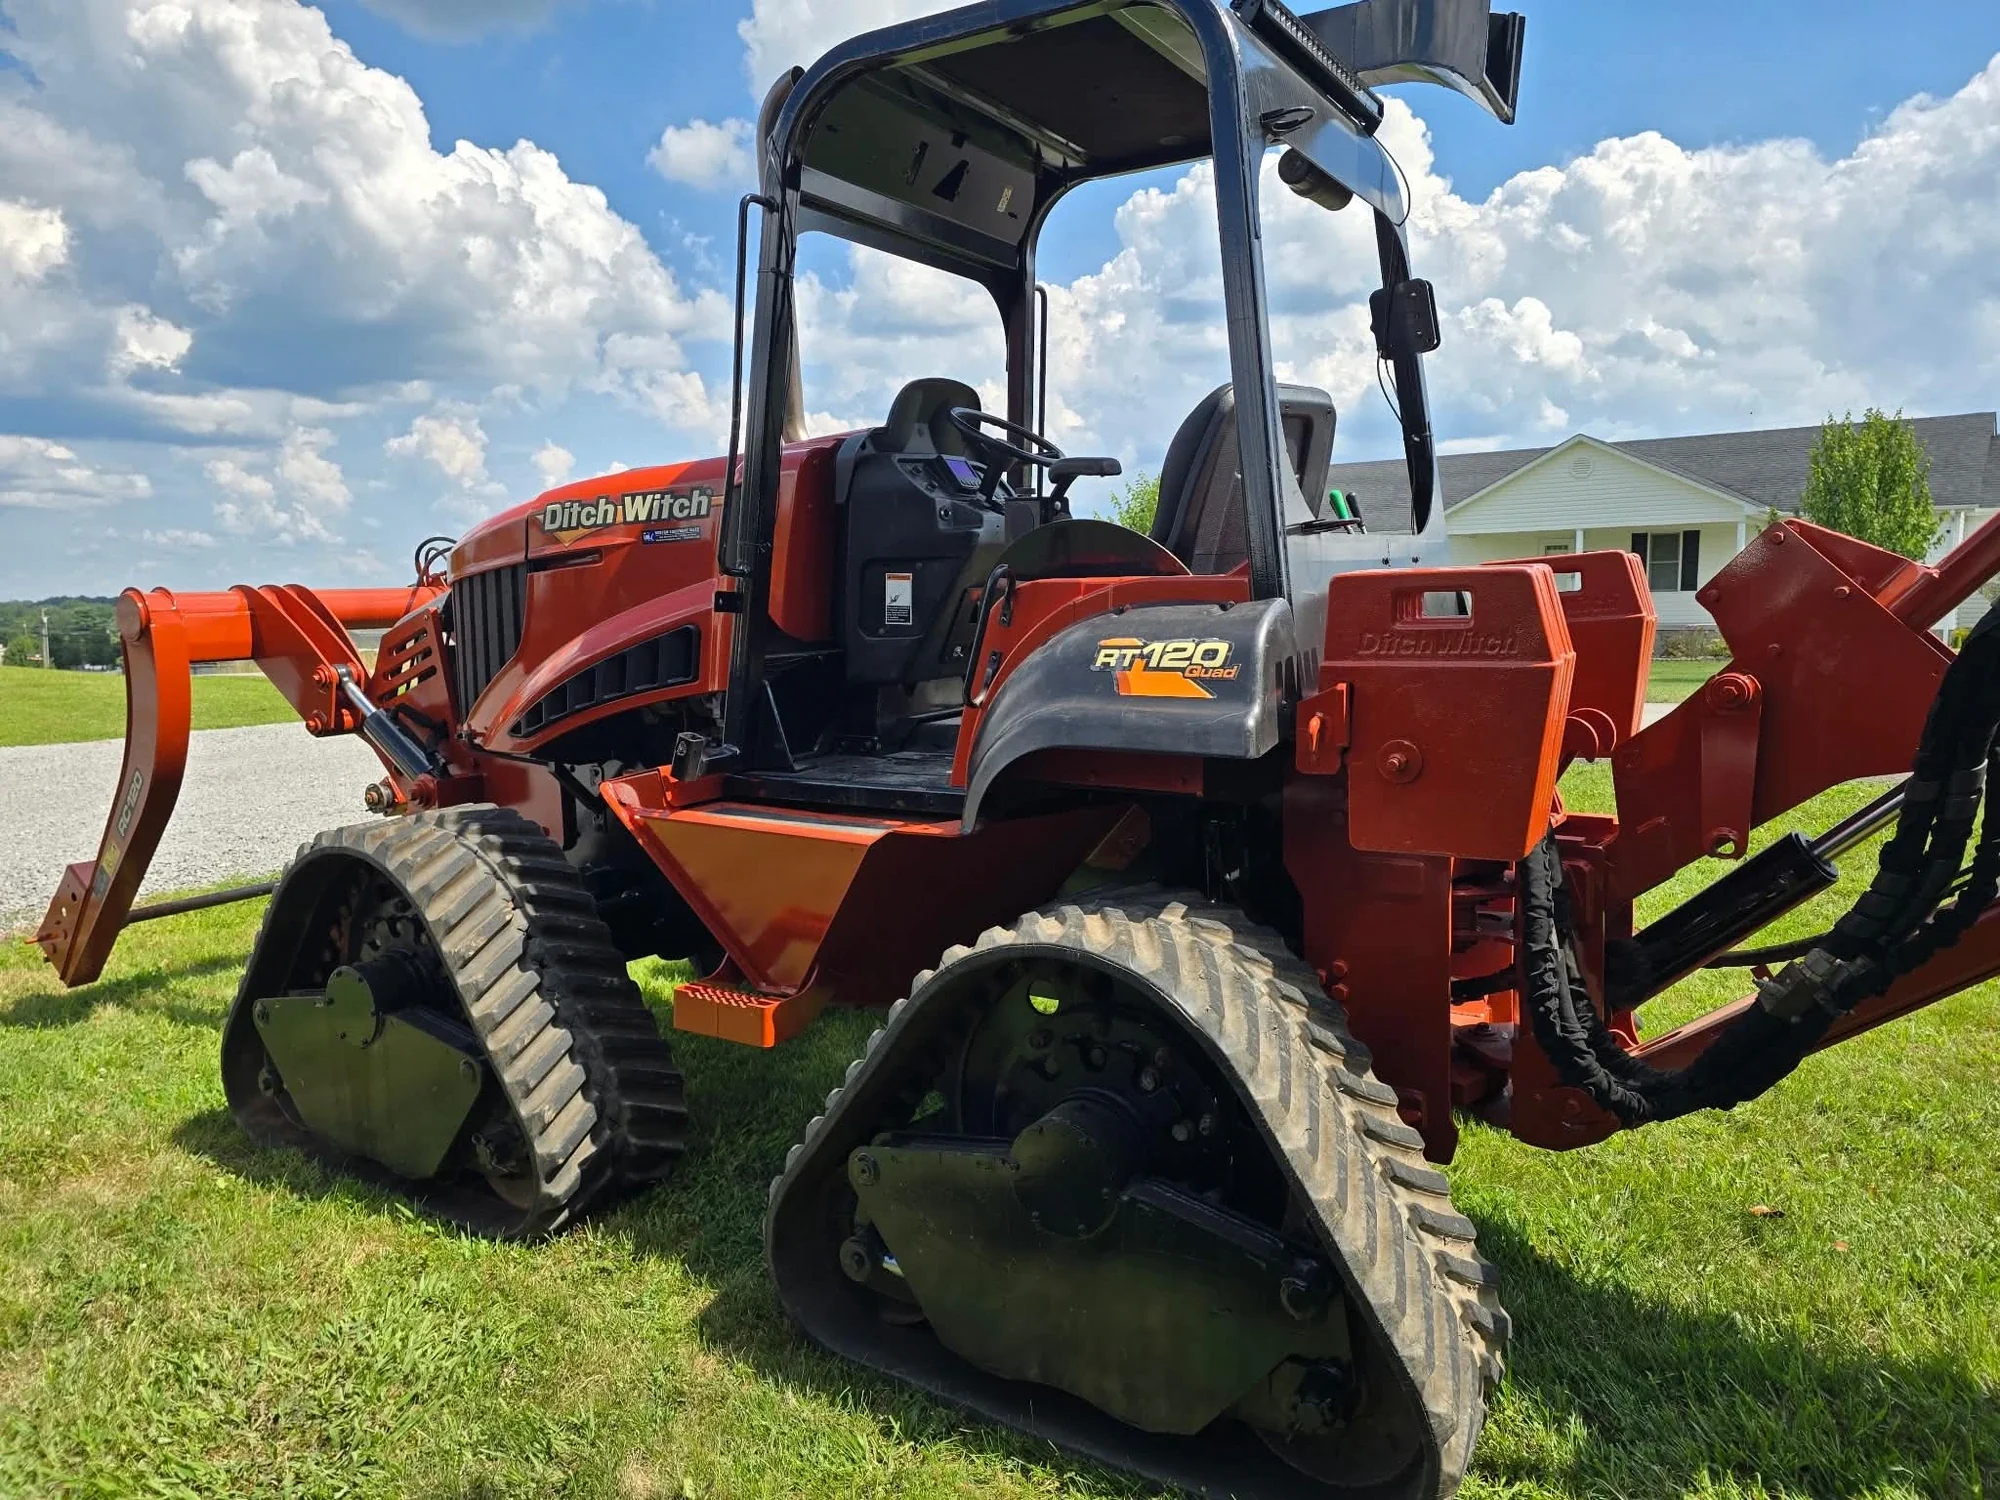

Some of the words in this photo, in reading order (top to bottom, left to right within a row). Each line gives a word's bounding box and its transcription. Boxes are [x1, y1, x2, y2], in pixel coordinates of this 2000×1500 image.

[544, 498, 615, 531] Ditch
[624, 489, 709, 522] Witch
[1095, 642, 1229, 668] RT120
[1356, 631, 1435, 656] Ditch
[1184, 664, 1240, 679] Quad
